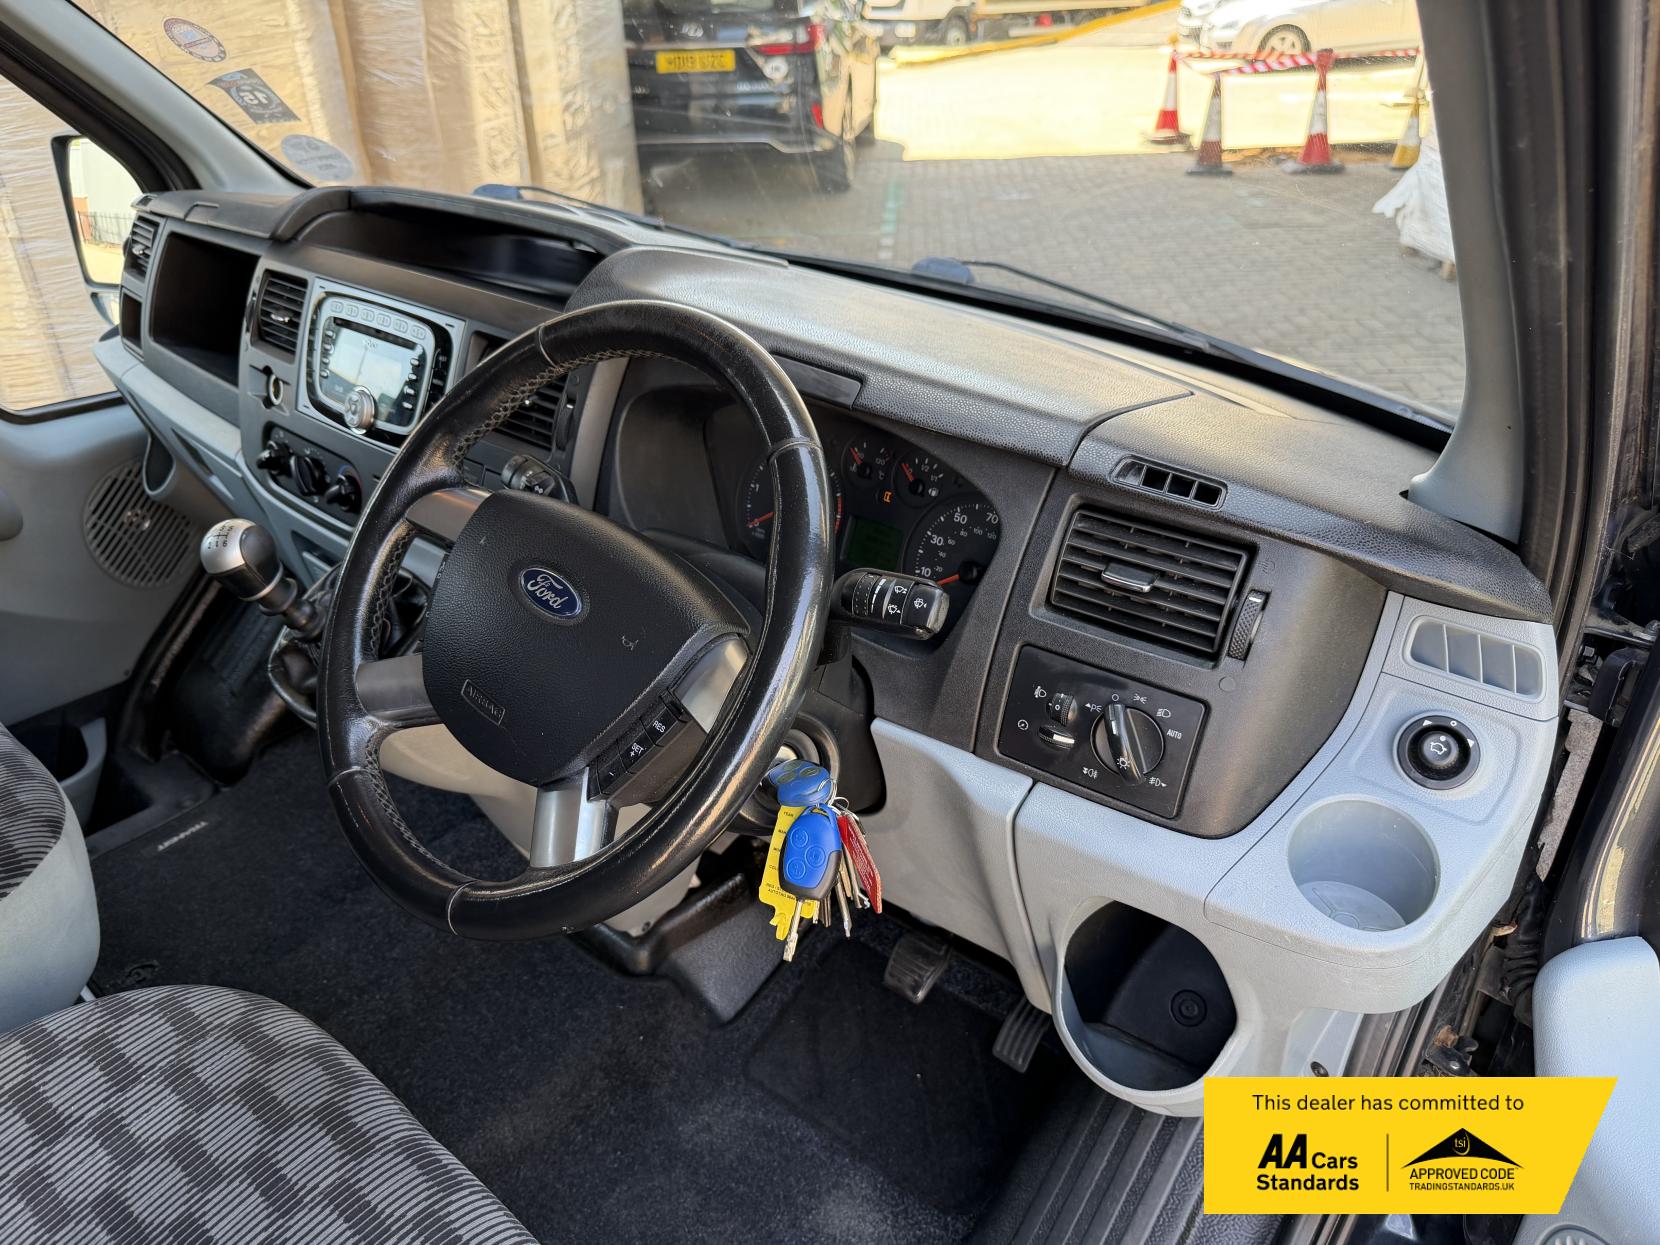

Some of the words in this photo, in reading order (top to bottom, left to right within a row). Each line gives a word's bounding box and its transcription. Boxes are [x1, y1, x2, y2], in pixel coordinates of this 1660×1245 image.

[953, 511, 968, 525] 50
[985, 512, 999, 525] 70
[930, 533, 944, 547] 30
[920, 565, 932, 578] 10
[526, 573, 570, 611] Ford
[652, 720, 667, 733] RES
[1166, 728, 1183, 740] AUTO
